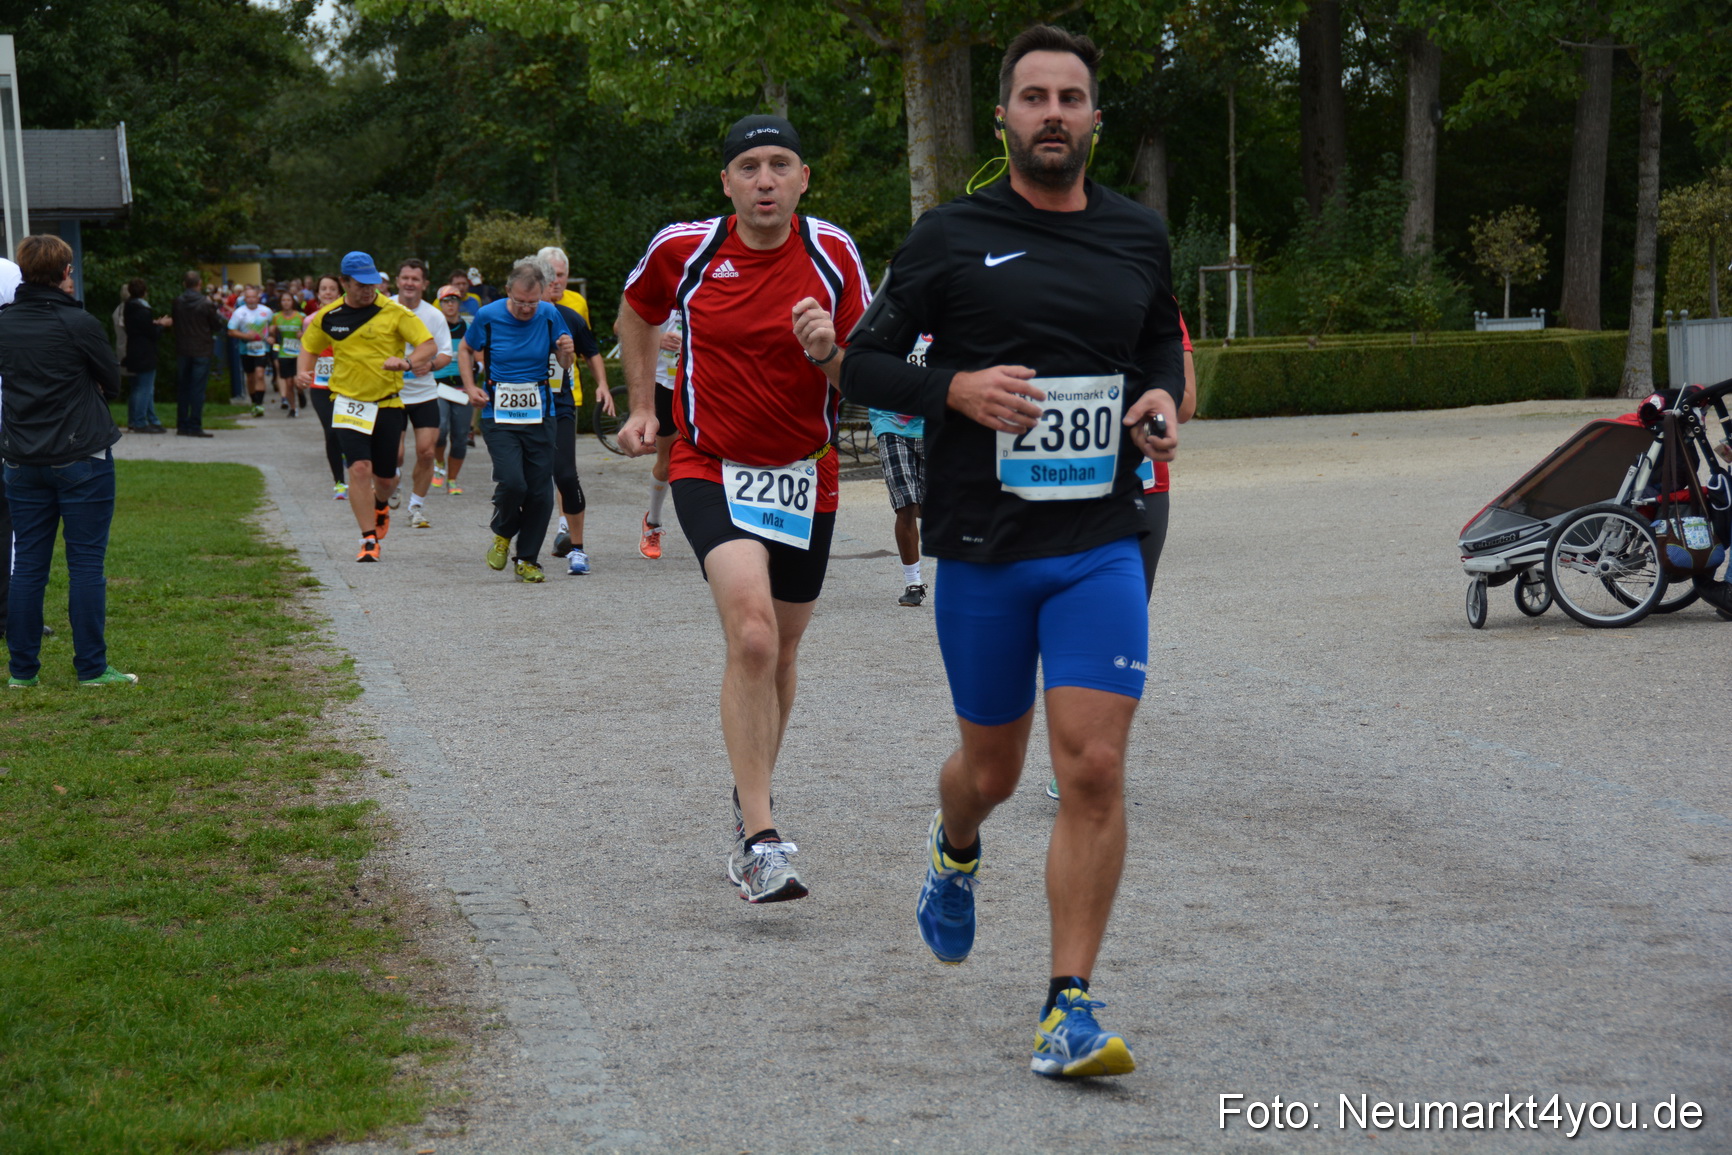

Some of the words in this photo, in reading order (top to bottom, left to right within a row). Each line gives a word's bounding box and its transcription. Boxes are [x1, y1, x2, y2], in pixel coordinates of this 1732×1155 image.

[712, 270, 740, 278] adidas
[500, 393, 537, 408] 2830
[1047, 390, 1104, 401] Neumarkt
[346, 402, 365, 417] 52
[1031, 464, 1095, 485] Stephan
[735, 471, 810, 511] 2208
[762, 512, 784, 529] Max
